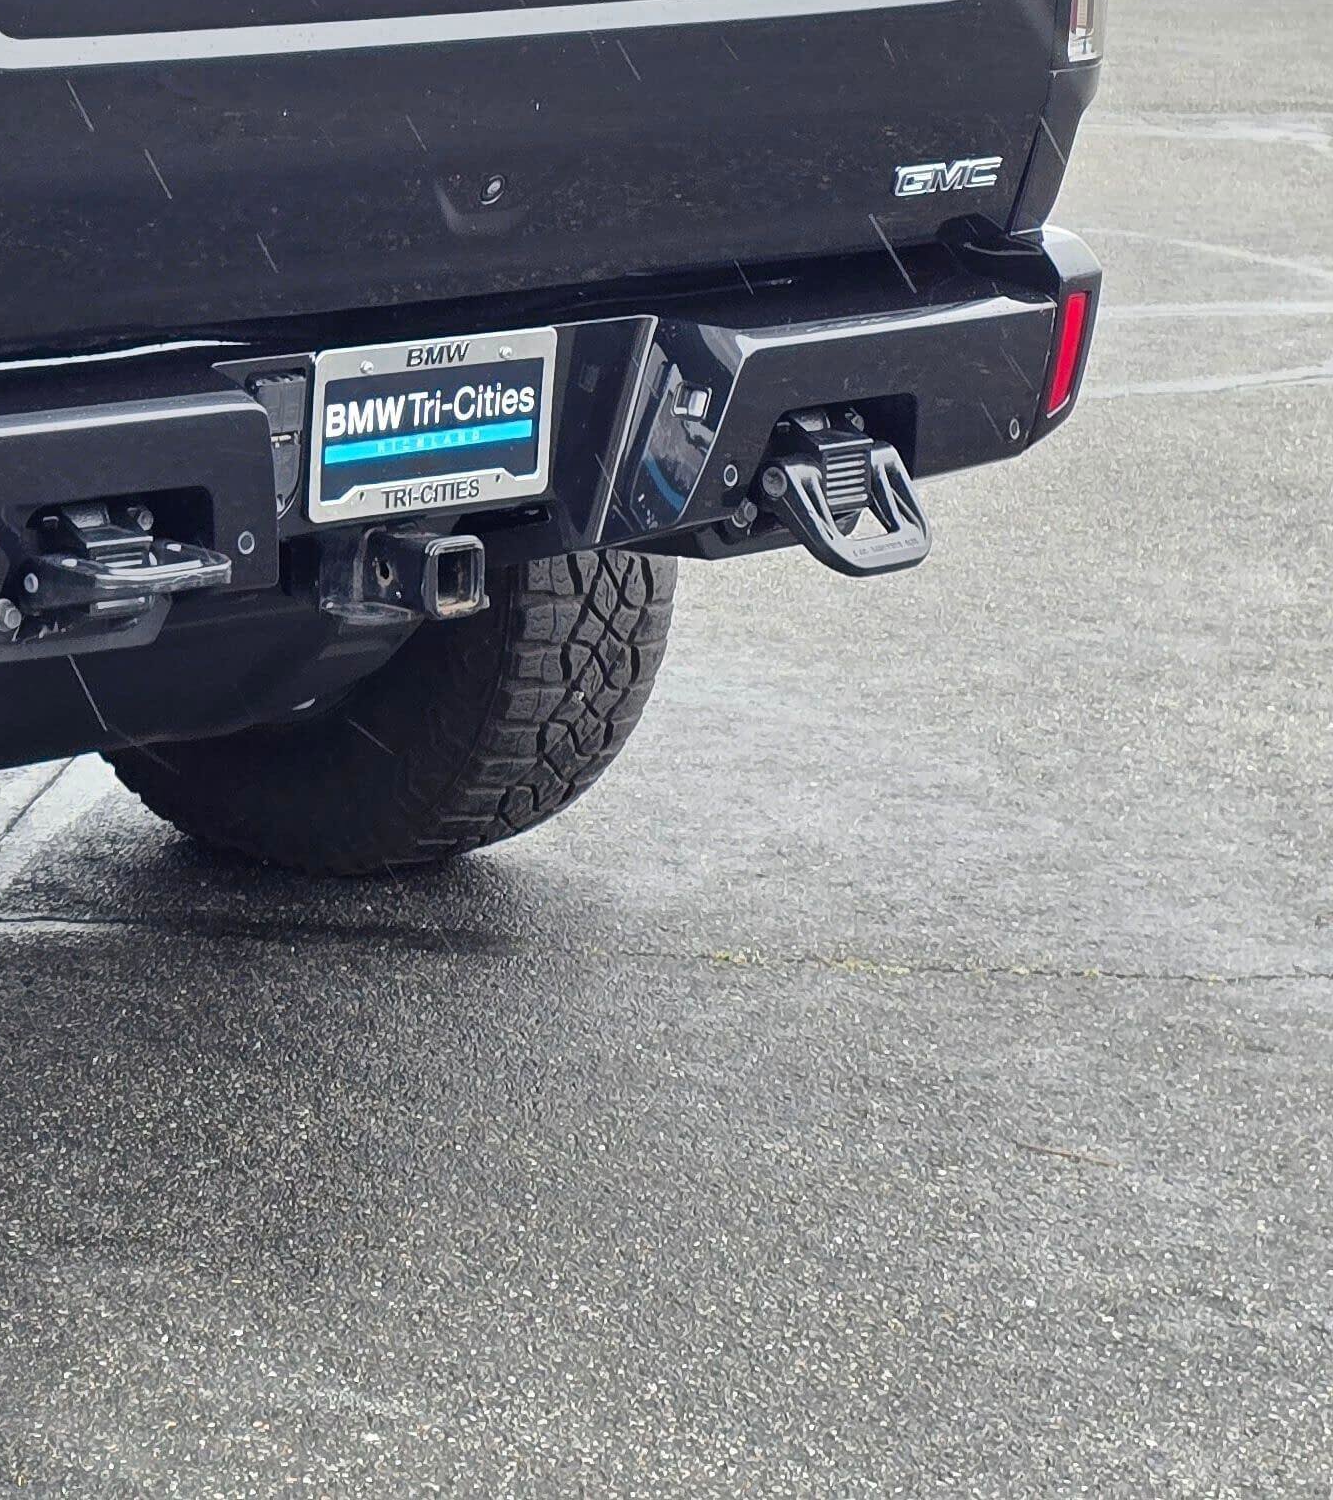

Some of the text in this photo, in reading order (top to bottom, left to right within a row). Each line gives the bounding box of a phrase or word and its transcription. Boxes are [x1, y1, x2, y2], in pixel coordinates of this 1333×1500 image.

[895, 156, 1003, 196] GMC
[406, 341, 470, 367] BMW
[325, 383, 535, 438] BMW Tri-Cities
[383, 479, 480, 509] TRI-CITIES
